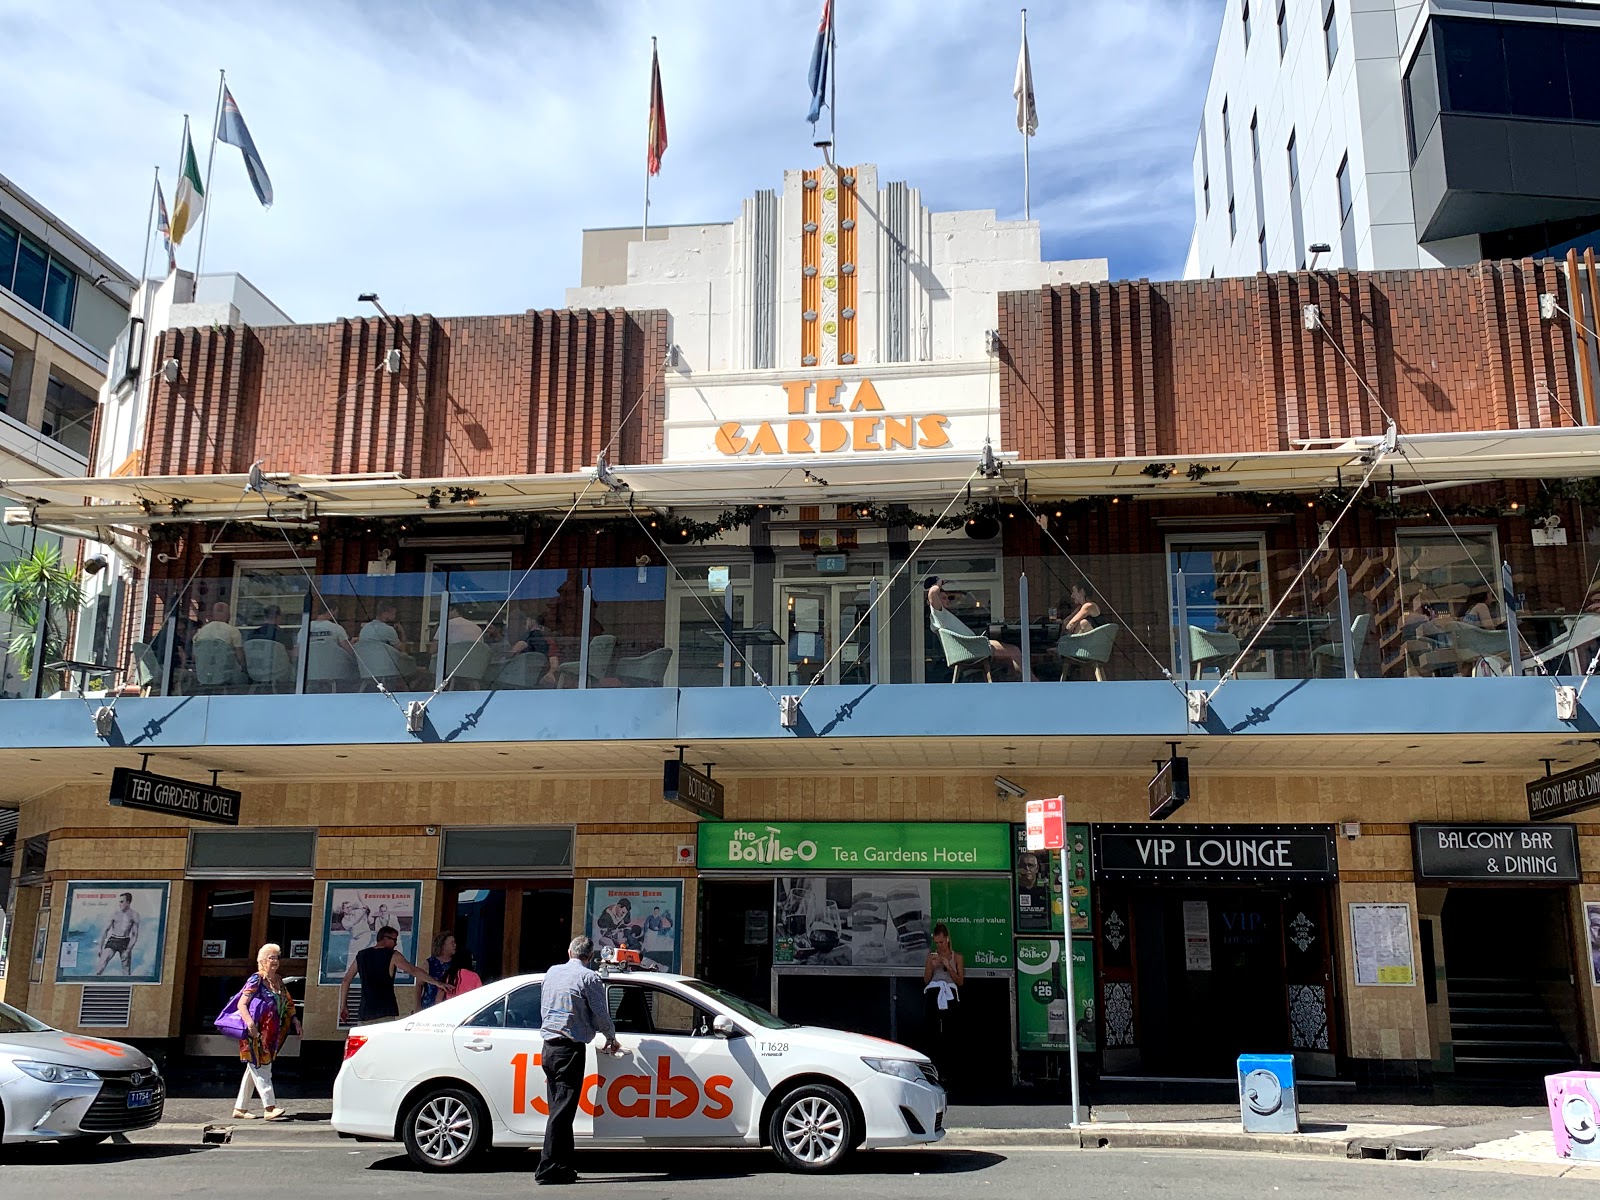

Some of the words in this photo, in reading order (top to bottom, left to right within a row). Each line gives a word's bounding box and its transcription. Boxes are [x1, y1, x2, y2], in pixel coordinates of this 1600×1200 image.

[783, 378, 885, 415] TEA
[715, 414, 953, 455] GARDENS
[132, 778, 152, 802] TEA
[154, 783, 201, 810] GARDENS
[202, 792, 234, 817] HOTEL
[1530, 783, 1562, 811] BALCONY
[1562, 779, 1579, 803] BAR
[1578, 779, 1586, 798] &
[1047, 801, 1056, 810] NO
[734, 827, 756, 840] the
[1438, 832, 1514, 849] BALCONY
[1521, 832, 1553, 849] BAR
[831, 846, 858, 861] Tea
[863, 846, 928, 862] Gardens
[933, 847, 977, 862] Hotel
[1136, 839, 1176, 866] VIP
[1186, 839, 1293, 867] LOUNGE
[1487, 858, 1500, 873] &
[1504, 856, 1558, 873] DINING
[949, 916, 972, 924] locals,
[760, 1041, 767, 1051] T
[768, 1042, 789, 1051] 1628
